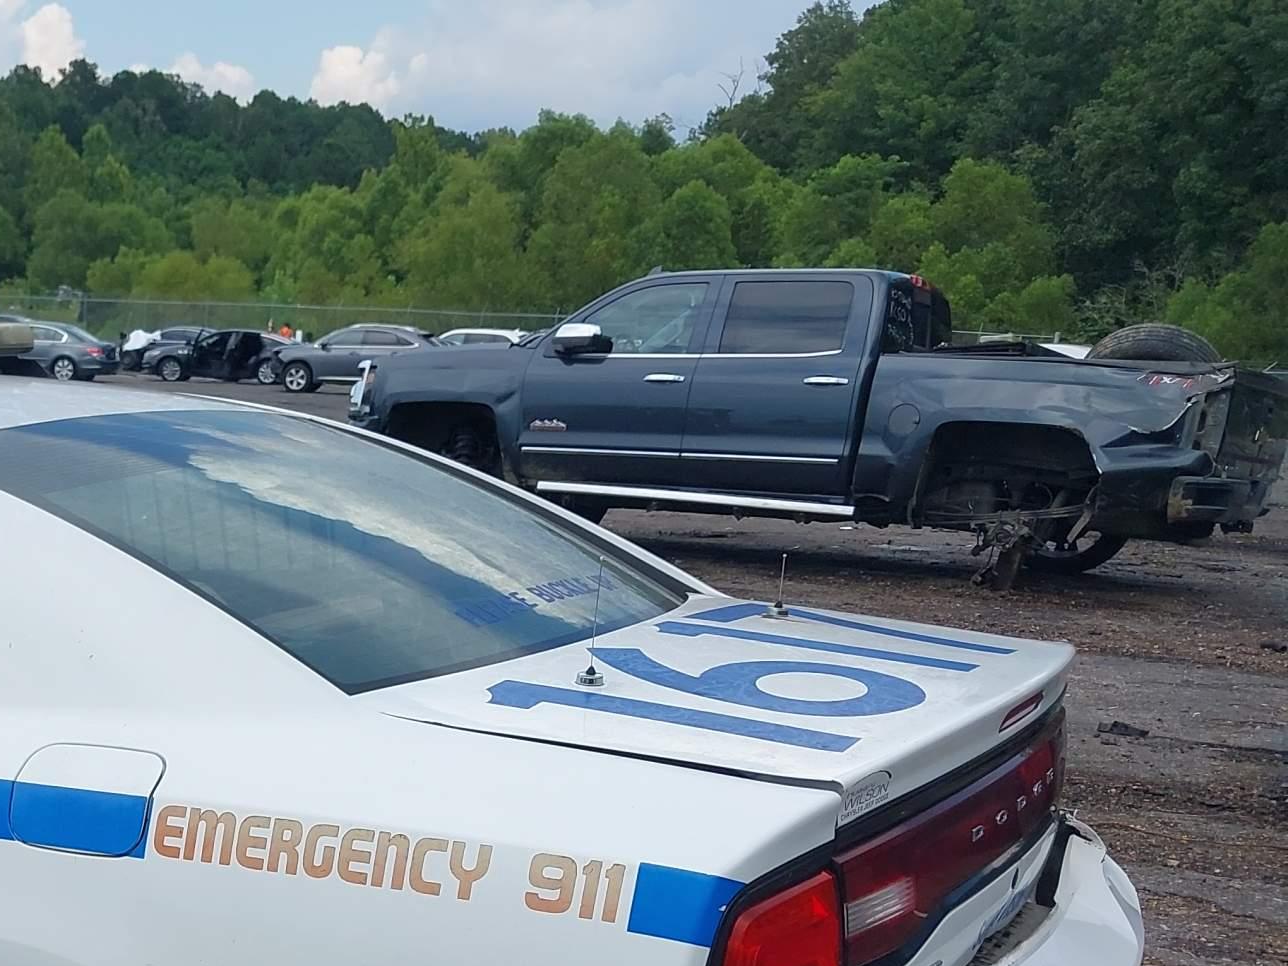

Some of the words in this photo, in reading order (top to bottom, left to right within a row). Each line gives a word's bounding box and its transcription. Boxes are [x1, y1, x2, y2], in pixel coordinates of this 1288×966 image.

[843, 781, 890, 811] WILSON
[971, 767, 1055, 843] DODGE
[153, 804, 494, 901] EMERGENCY
[524, 852, 627, 924] 911
